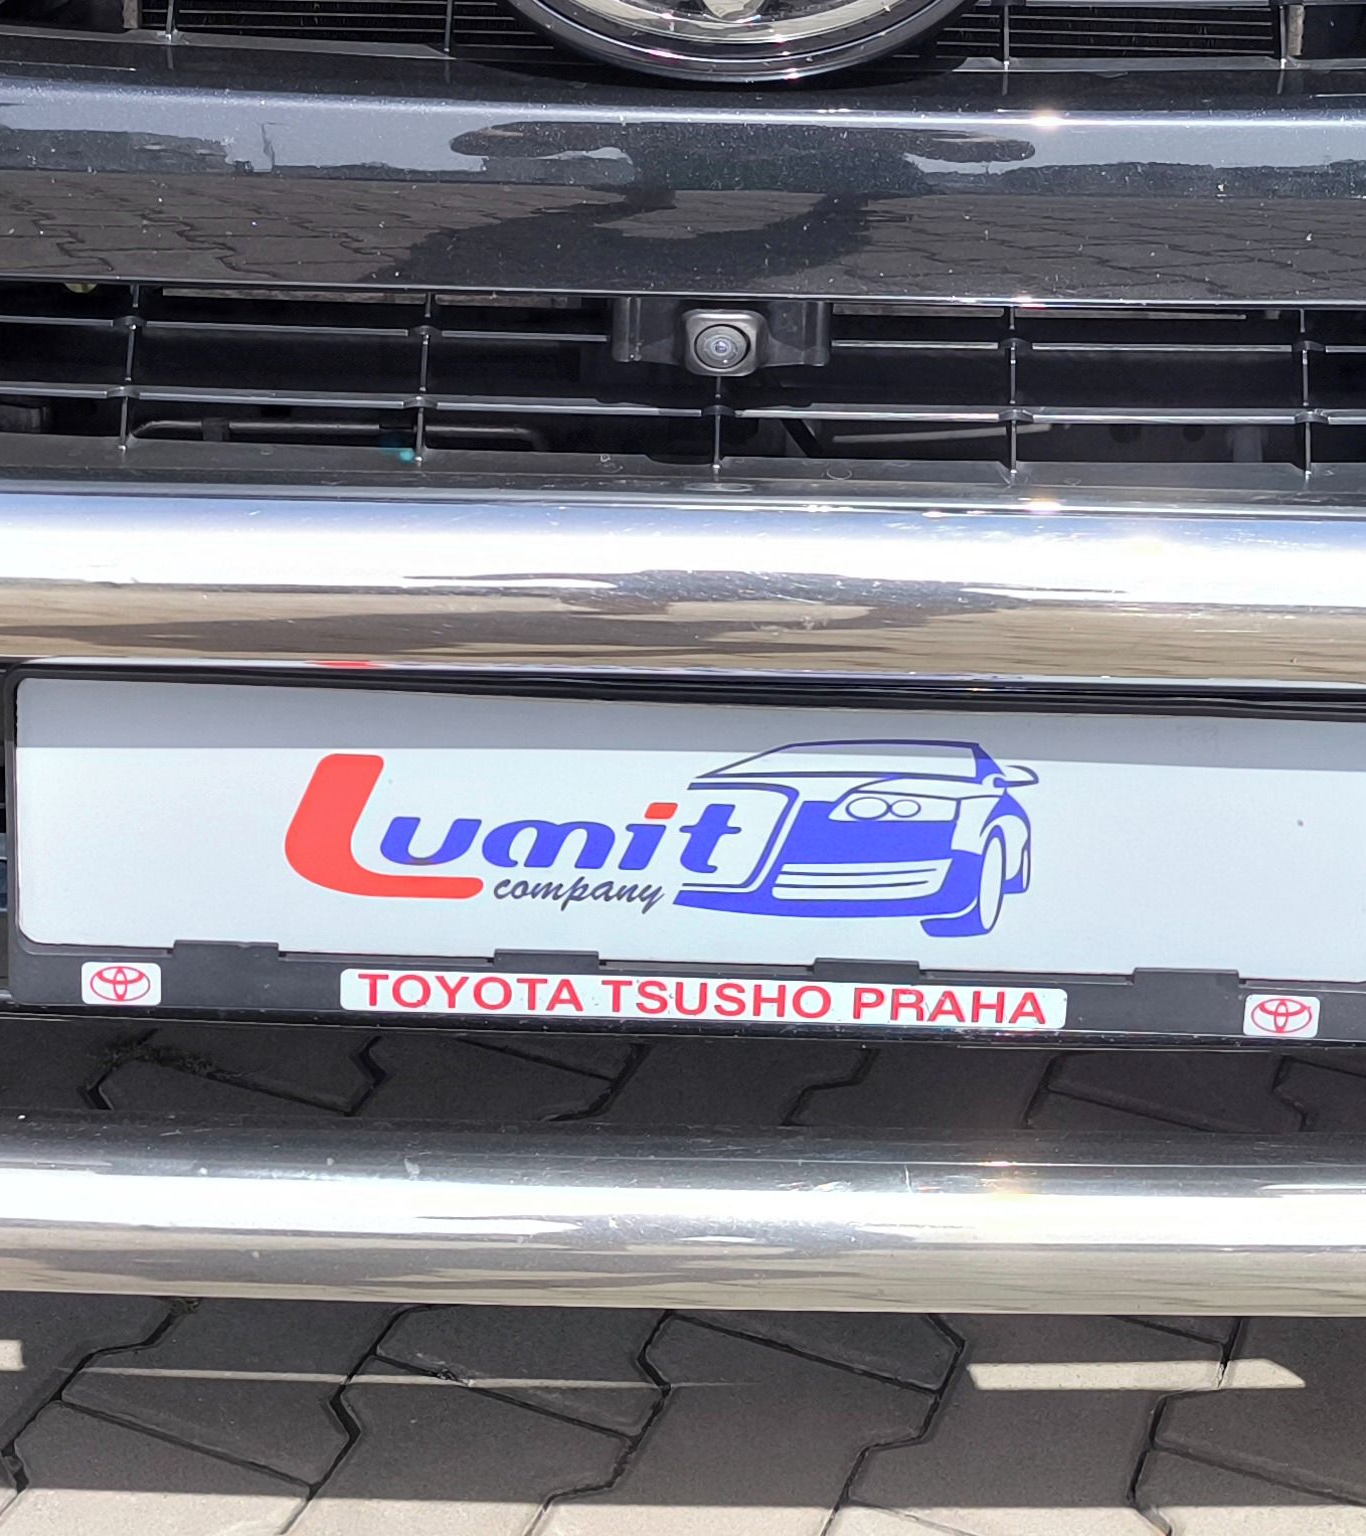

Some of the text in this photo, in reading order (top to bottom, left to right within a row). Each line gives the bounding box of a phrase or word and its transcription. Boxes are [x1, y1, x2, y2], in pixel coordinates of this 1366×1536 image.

[283, 753, 742, 900] Lumit
[493, 875, 665, 914] company
[357, 972, 1047, 1025] TOYOTA TSUSHO PRAHA
